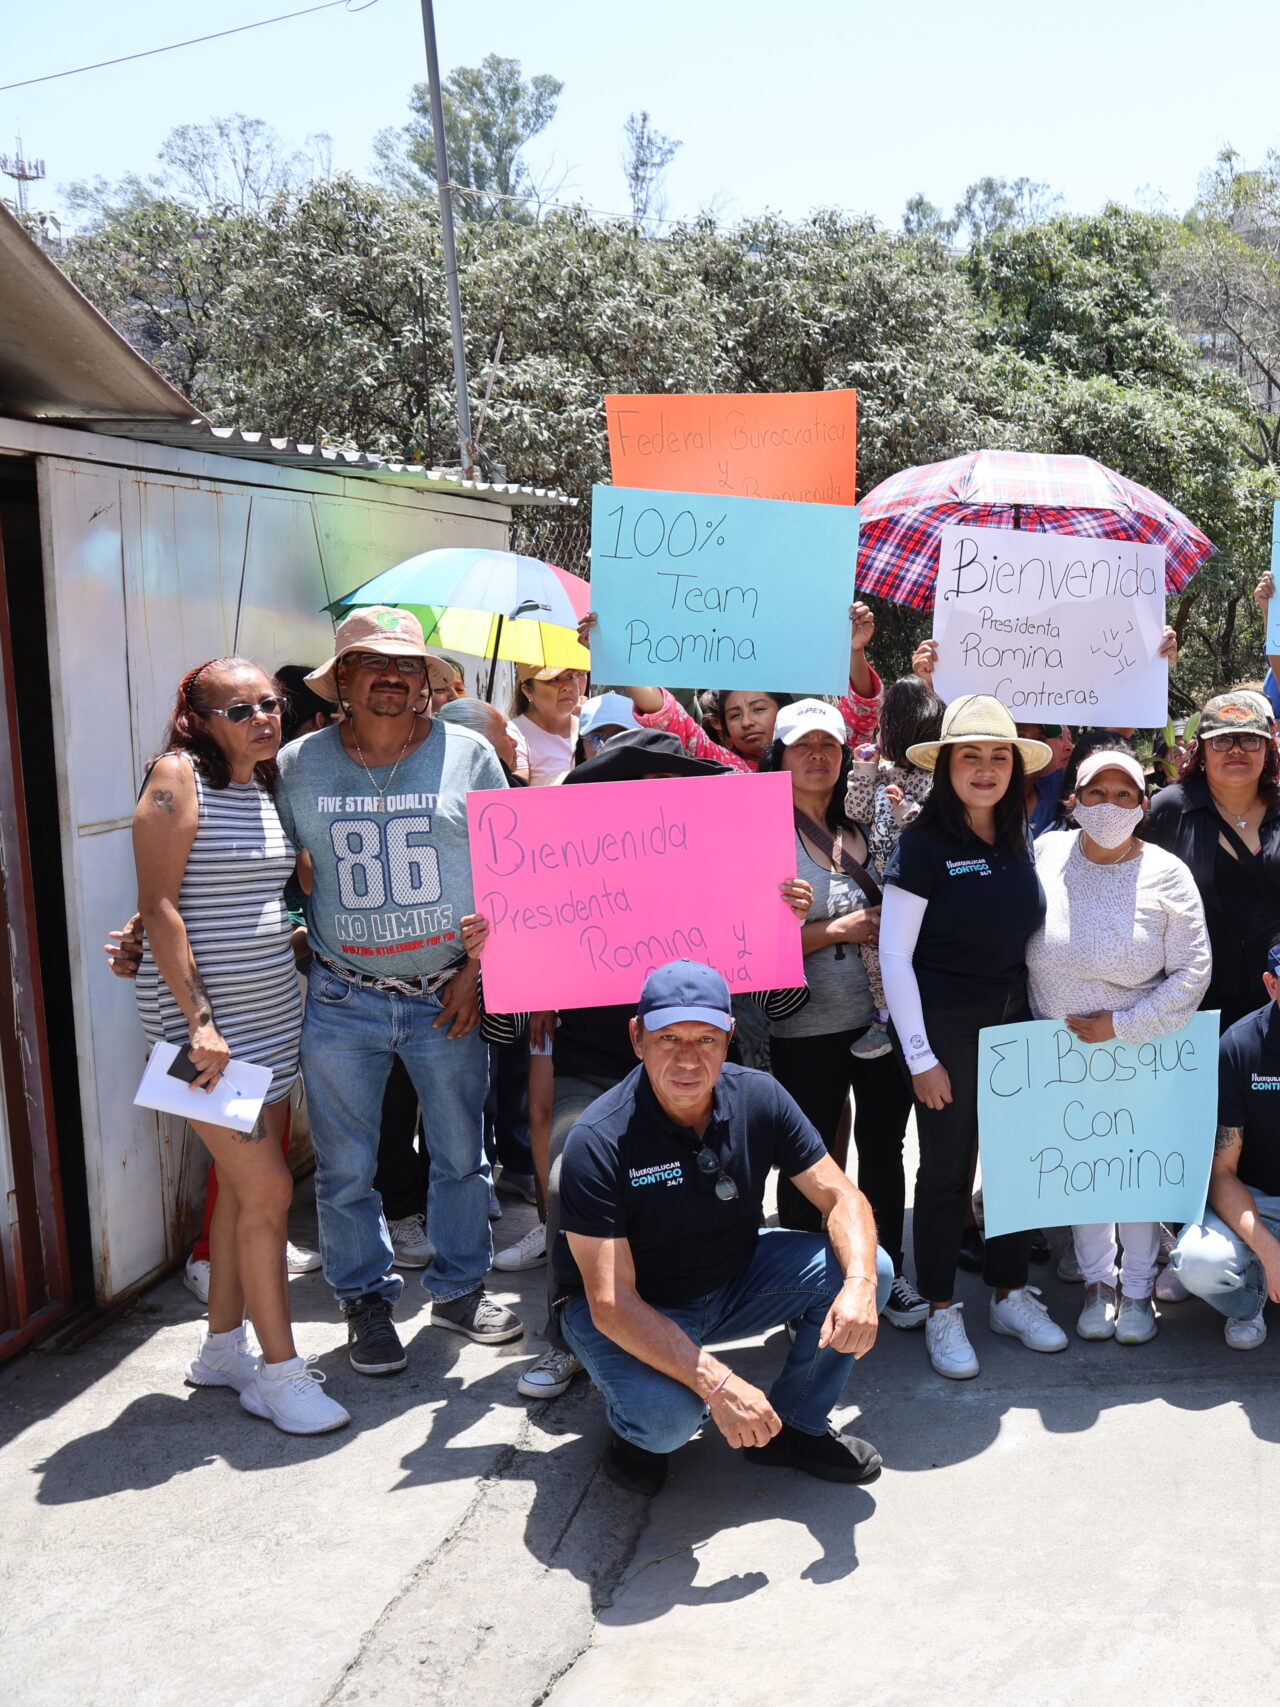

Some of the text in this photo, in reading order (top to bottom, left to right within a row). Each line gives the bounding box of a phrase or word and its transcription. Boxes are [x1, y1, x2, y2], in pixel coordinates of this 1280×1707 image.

[609, 410, 846, 456] Federal Burocratica
[600, 505, 727, 559] 100%
[943, 538, 1157, 601] Bienvenida
[656, 572, 759, 619] Team
[625, 619, 757, 664] Romina
[979, 606, 1061, 639] Presidenta
[959, 632, 1064, 670] Romina
[994, 677, 1099, 709] Contreras
[317, 796, 342, 813] FIVE
[386, 793, 443, 813] QUALITY
[478, 802, 688, 876] Bienvenida
[329, 814, 443, 911] 86
[949, 863, 989, 876] CONTIGO
[334, 904, 453, 942] NO LIMITS
[482, 876, 632, 935] Presidenta
[579, 925, 708, 973] Romina
[732, 919, 752, 959] y
[989, 1029, 1198, 1097] El Bosque
[1063, 1100, 1135, 1141] Con
[629, 1161, 681, 1178] HUIXQUILUCAN
[631, 1168, 682, 1187] CONTIGO
[666, 1178, 684, 1187] 24/7
[1030, 1147, 1185, 1200] Romina
